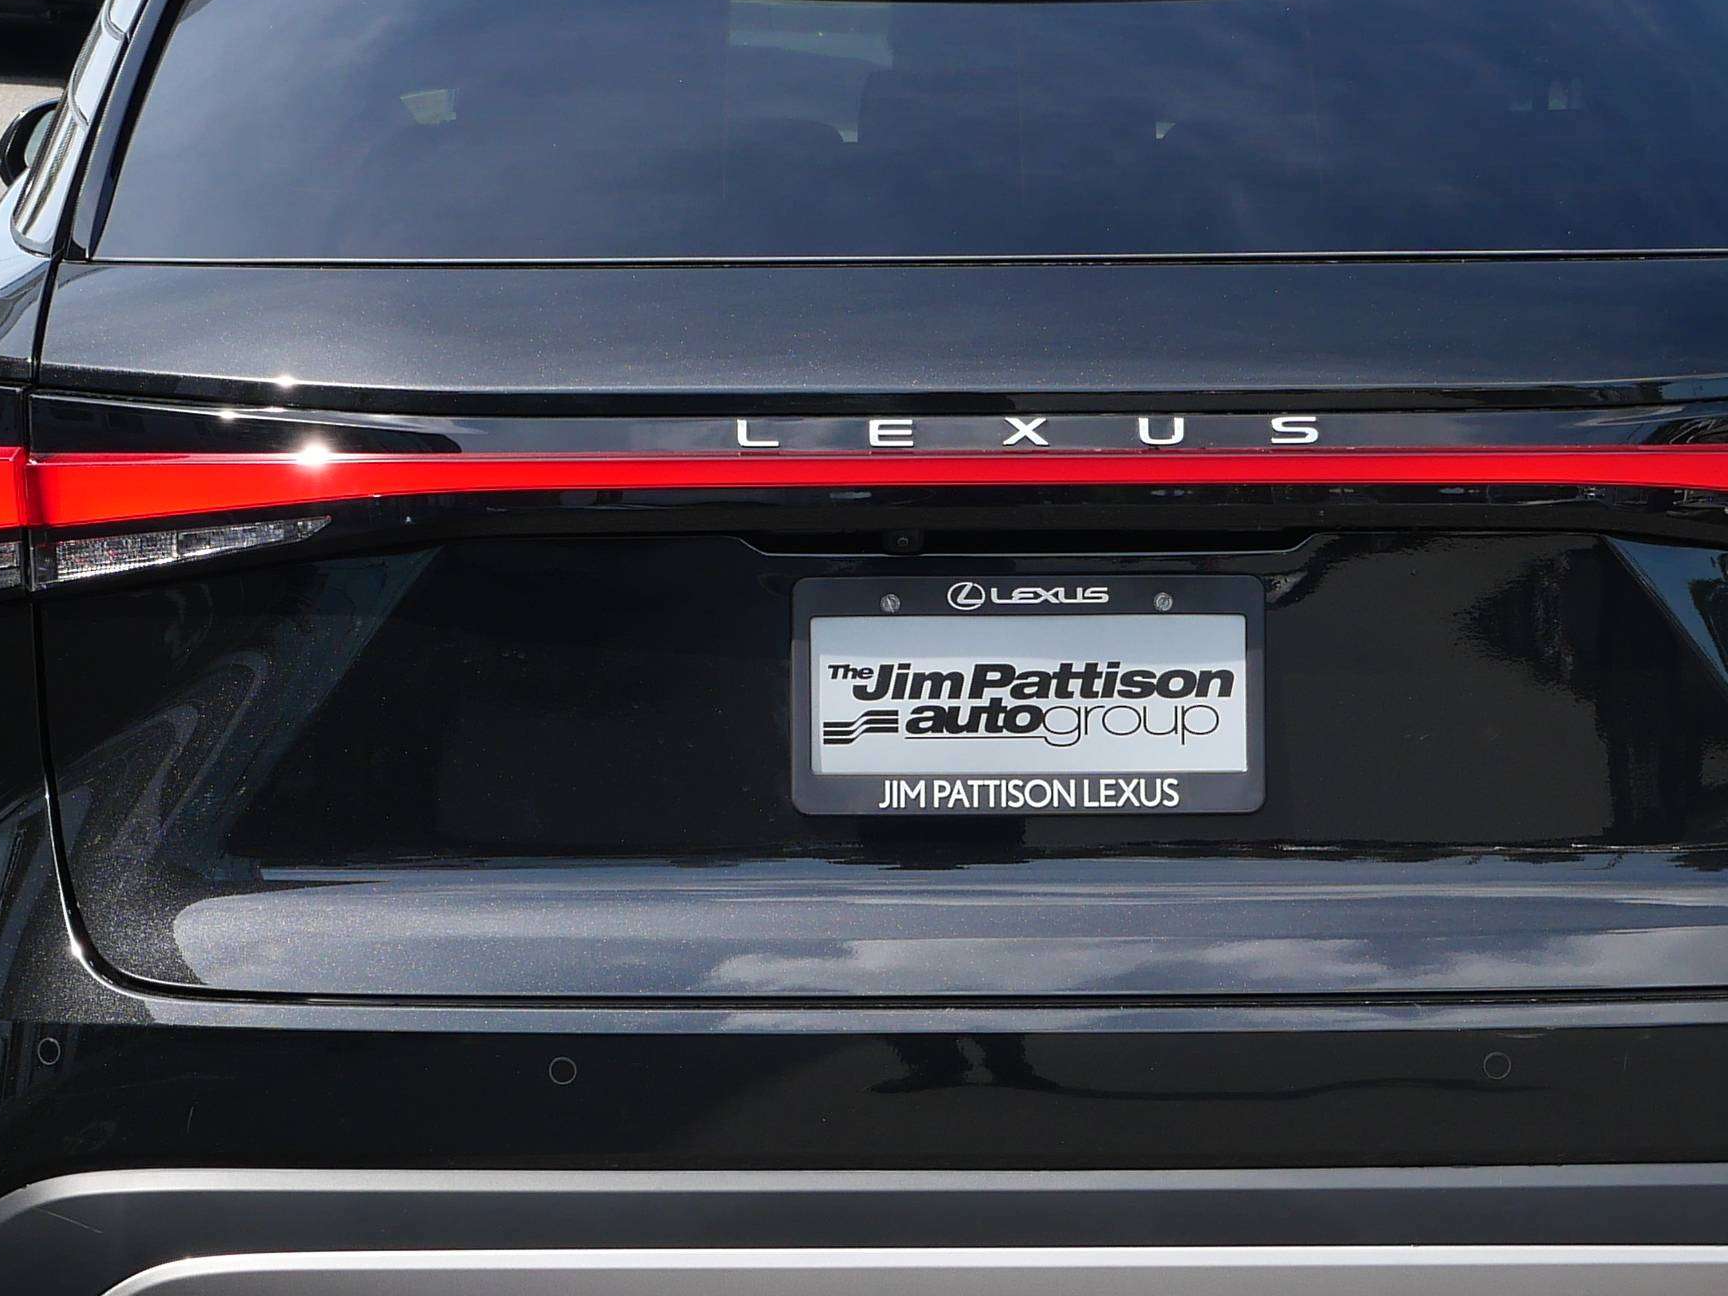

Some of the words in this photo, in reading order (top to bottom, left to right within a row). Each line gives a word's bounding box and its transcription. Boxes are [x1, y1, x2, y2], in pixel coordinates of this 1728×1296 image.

[736, 416, 1319, 447] LEXUS
[991, 587, 1109, 604] LEXUS
[827, 663, 874, 681] The
[878, 779, 926, 809] JIM
[933, 778, 1076, 808] PATTISON
[1083, 778, 1180, 808] LEXUS
